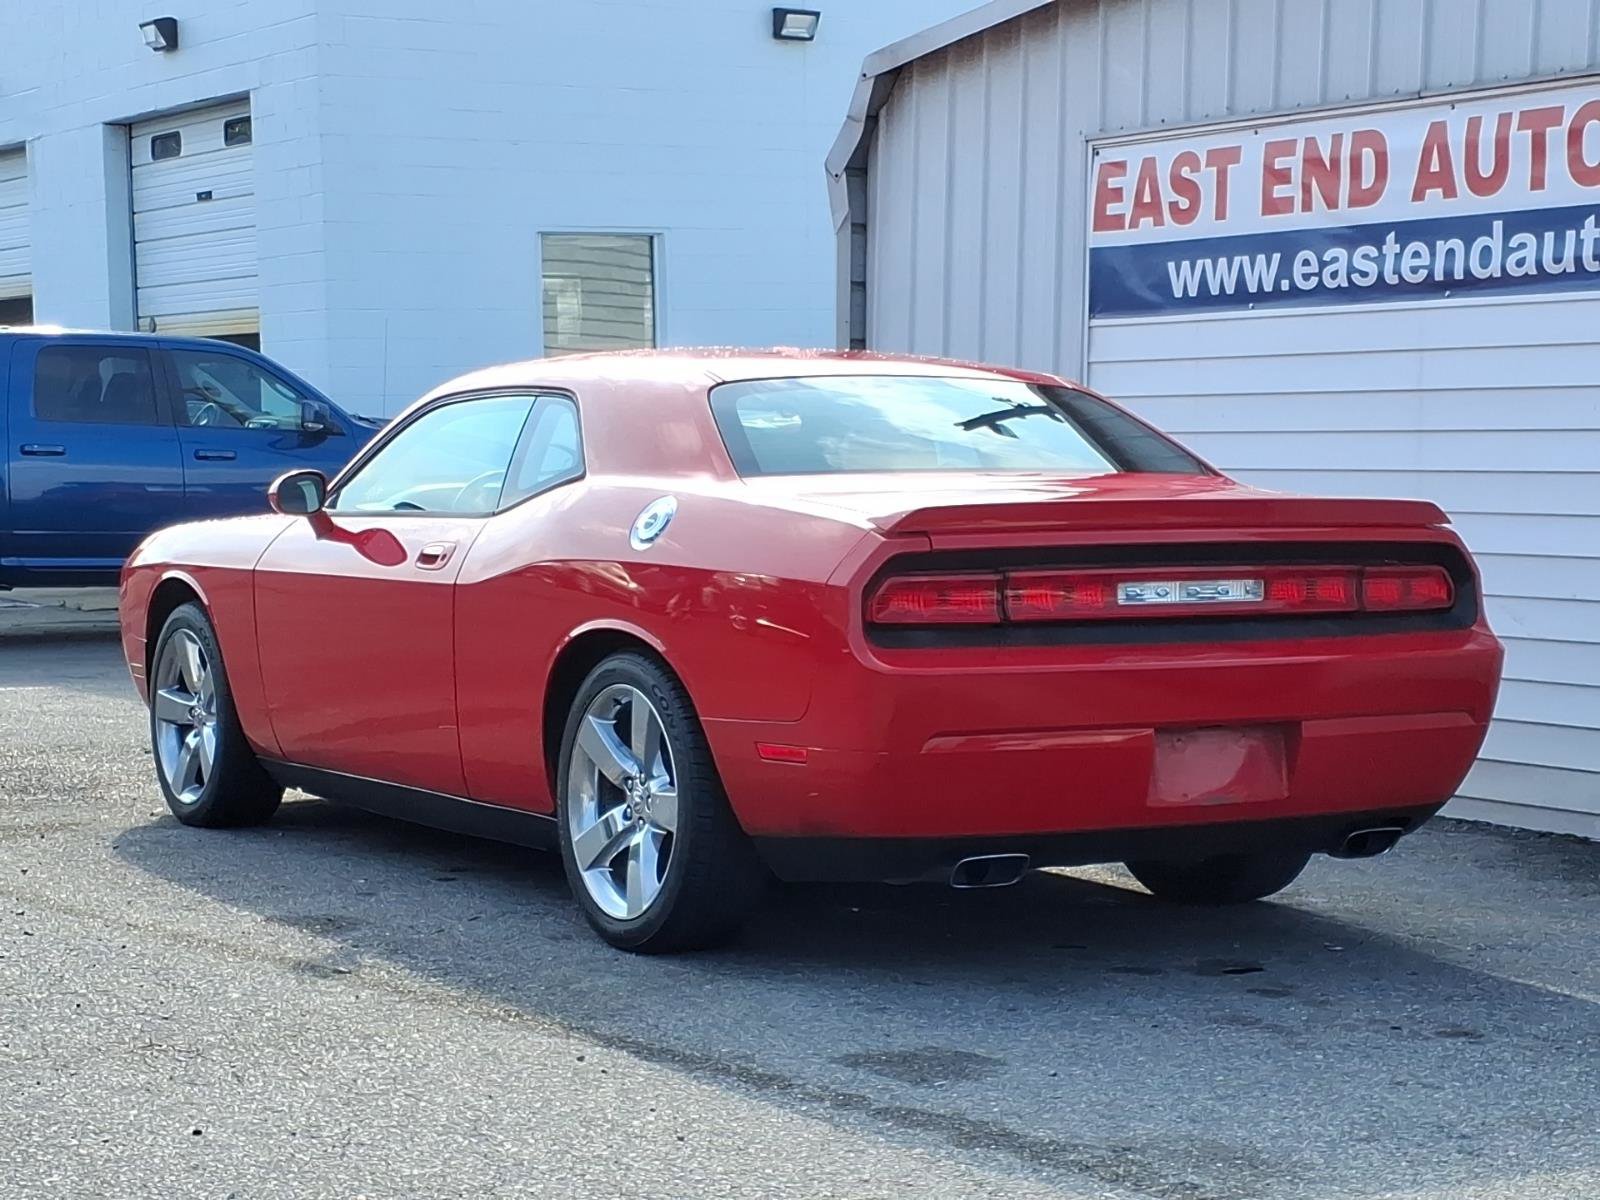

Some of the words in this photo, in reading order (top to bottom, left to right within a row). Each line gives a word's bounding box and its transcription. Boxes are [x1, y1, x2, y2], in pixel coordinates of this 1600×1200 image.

[1092, 145, 1242, 232] EAST
[1260, 128, 1389, 217] END
[1410, 99, 1600, 203] AUTO
[1167, 214, 1600, 298] www.eastendaut
